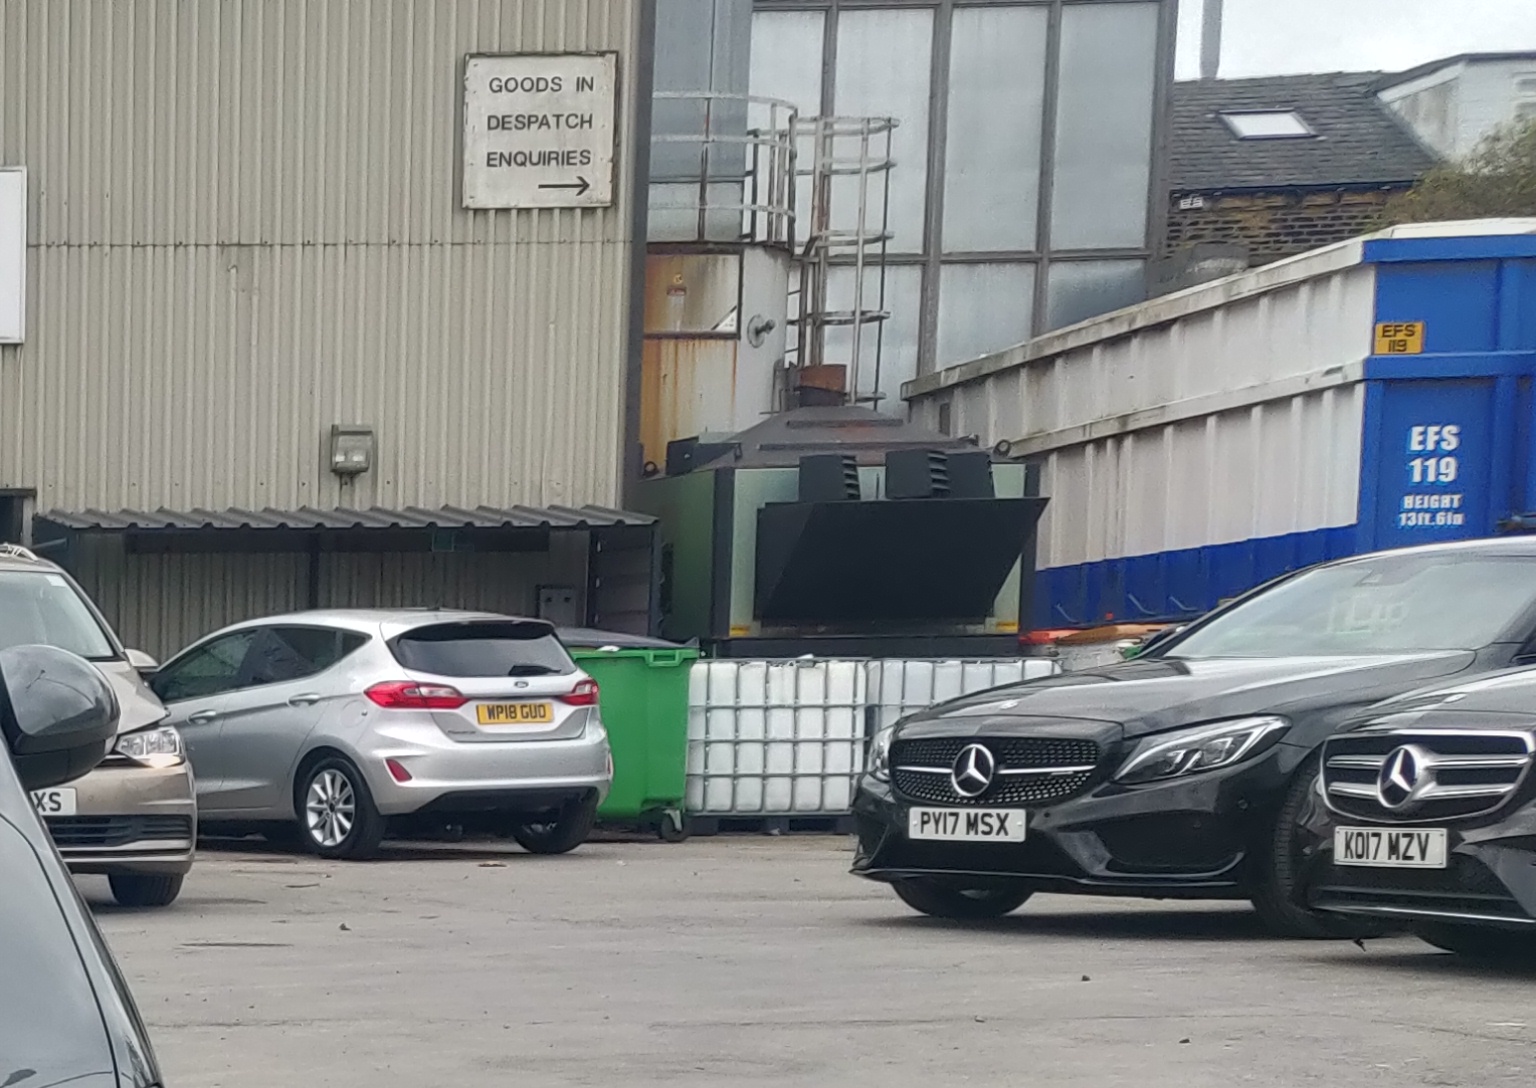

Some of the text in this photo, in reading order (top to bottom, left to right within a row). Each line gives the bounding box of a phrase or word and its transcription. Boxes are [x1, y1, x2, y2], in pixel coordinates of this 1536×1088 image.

[488, 76, 594, 93] GOODS IN
[487, 113, 593, 131] DESPATCH
[486, 149, 591, 168] ENQUIRIES
[1382, 323, 1416, 338] EFS
[1388, 339, 1408, 353] 119
[1409, 424, 1461, 452] EFS
[1408, 456, 1458, 484] 119
[1403, 494, 1464, 510] HEIGHT
[486, 704, 517, 720] WP18
[920, 811, 1010, 836] PY17 MSX
[1388, 832, 1430, 861] MZV
